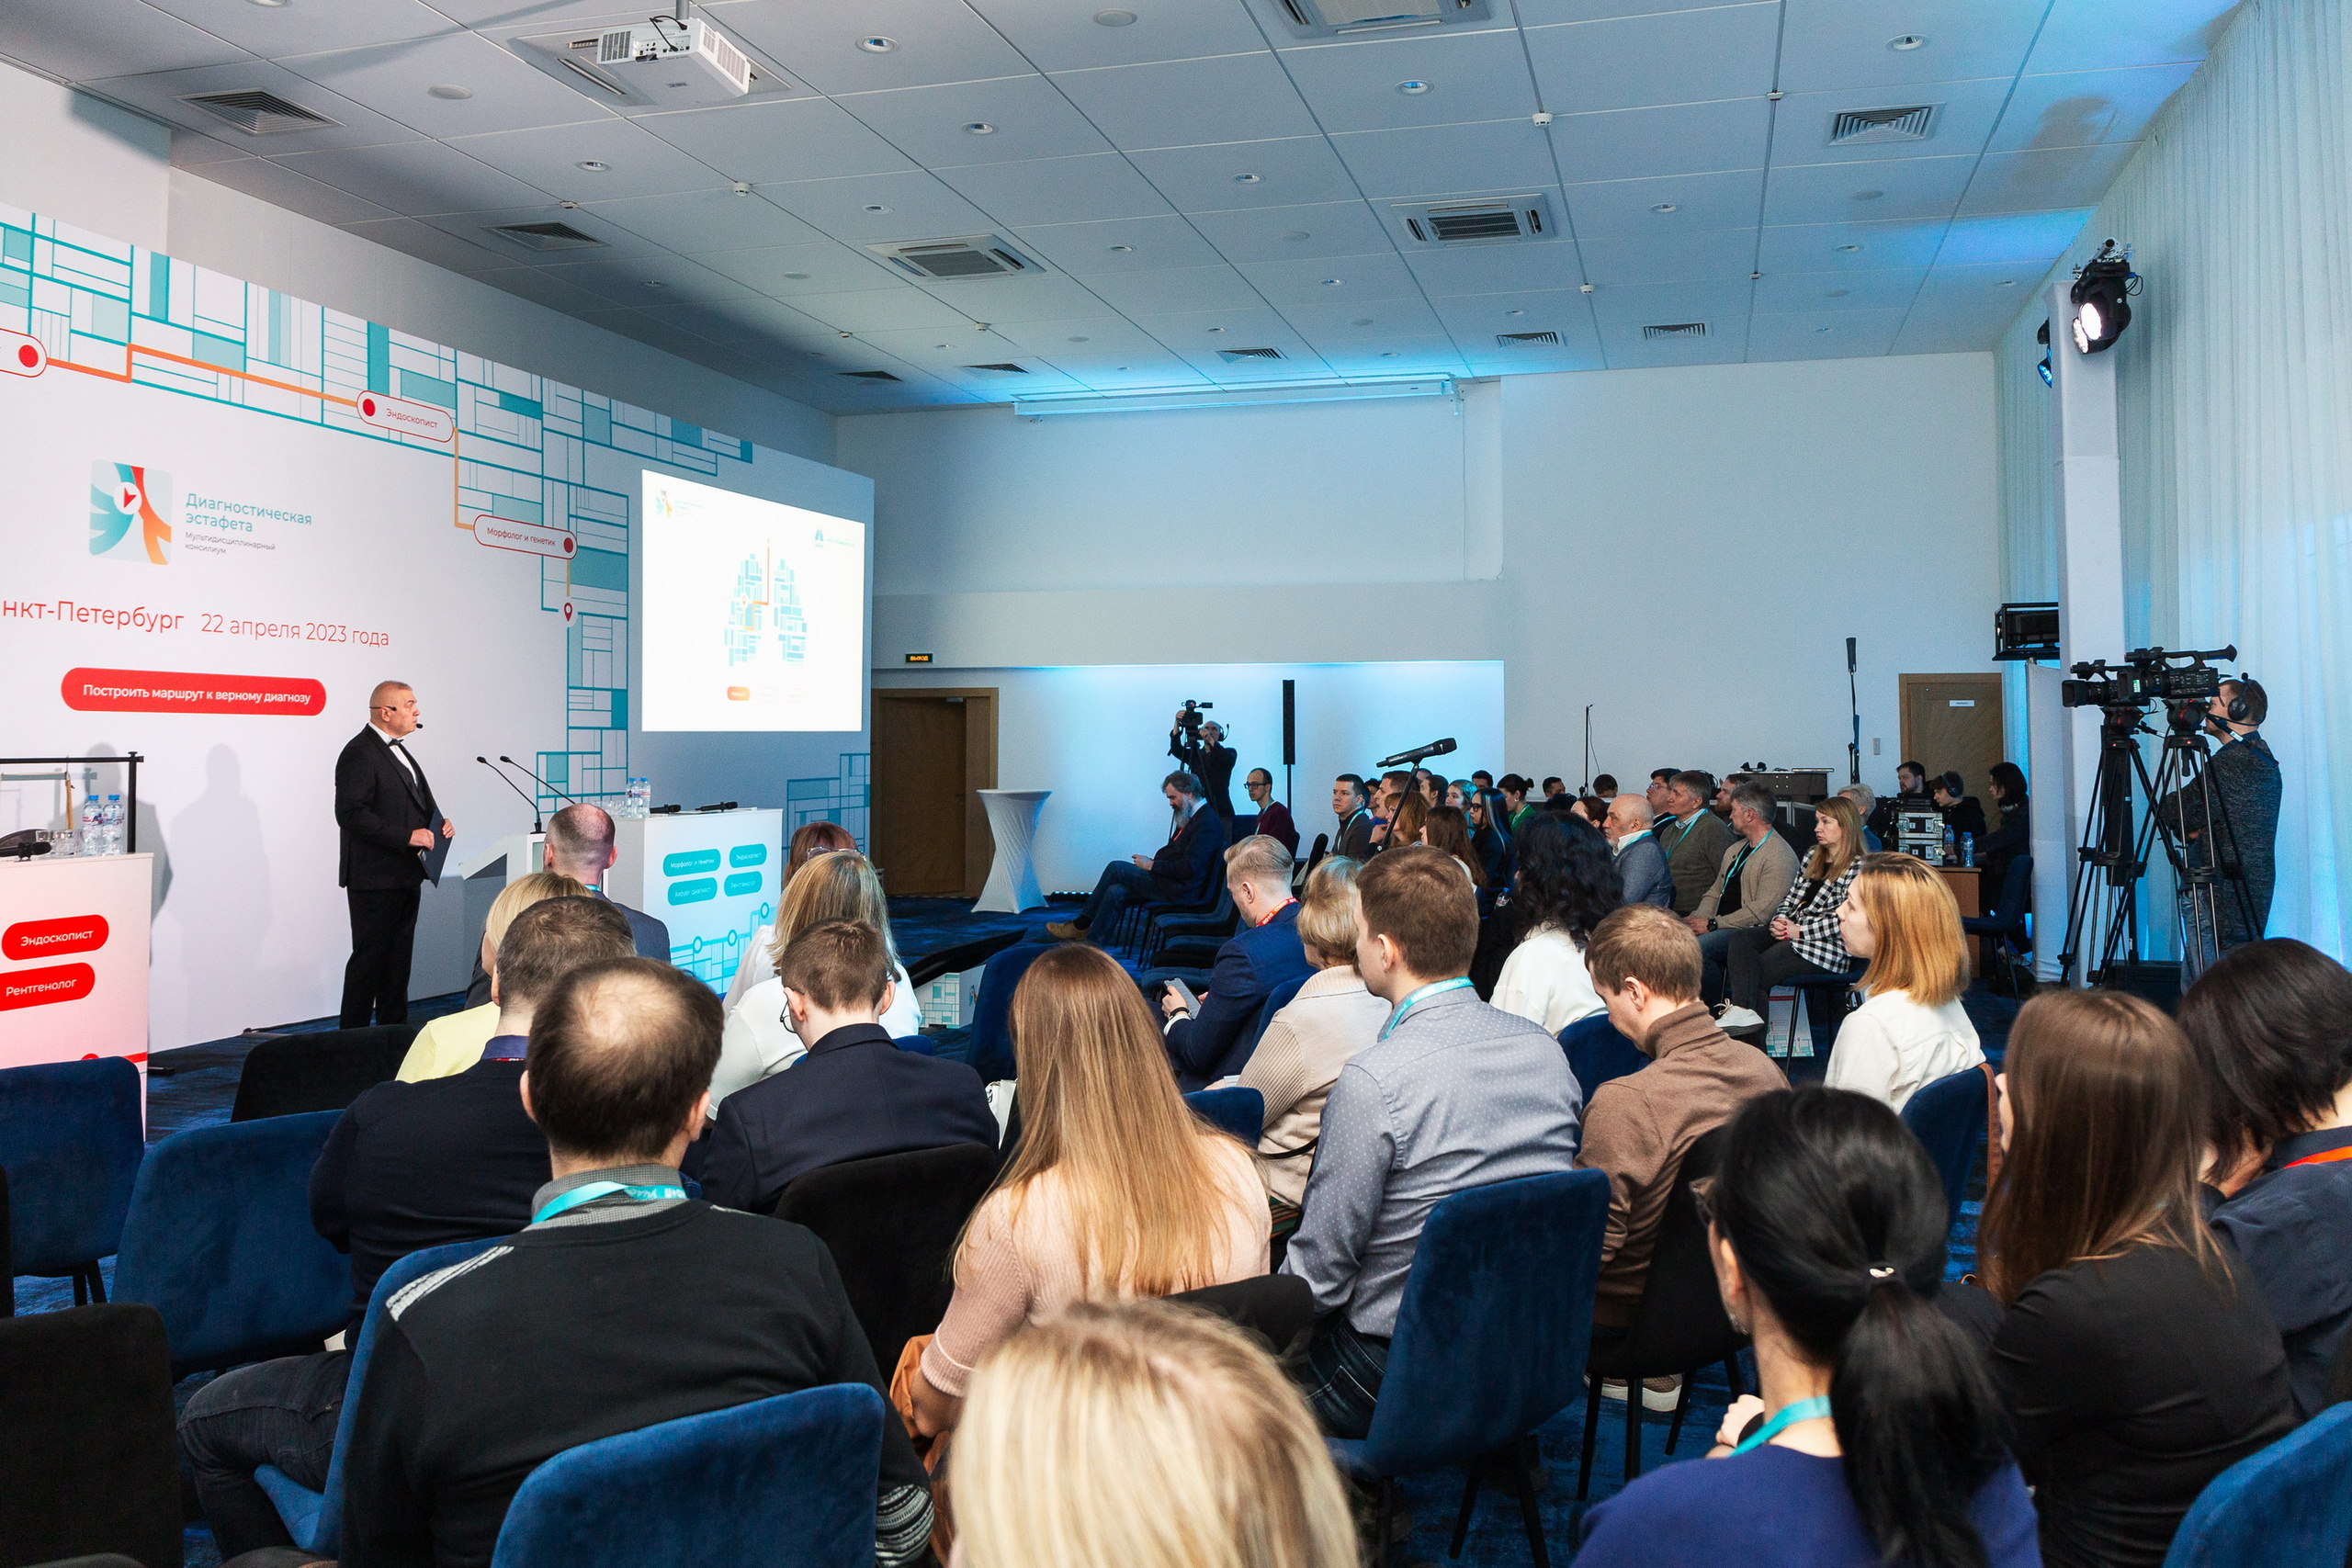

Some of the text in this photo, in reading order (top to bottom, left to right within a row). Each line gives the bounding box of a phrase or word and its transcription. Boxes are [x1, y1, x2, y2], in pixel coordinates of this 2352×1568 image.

[386, 408, 438, 429] Эндоскопист
[186, 492, 312, 525] Диагностическая
[186, 513, 253, 532] эстафета
[185, 531, 276, 551] Мультидисциплинарный
[487, 526, 523, 541] Морфолог
[530, 536, 557, 547] генетик
[185, 543, 226, 555] консилиум
[3, 600, 390, 648] нкт-Петербург 22 апреля 2023 года
[84, 684, 311, 705] Построить маршрут к верному диагнозу
[20, 931, 94, 946] Эндоскопист
[6, 979, 77, 998] Рентгенолог
